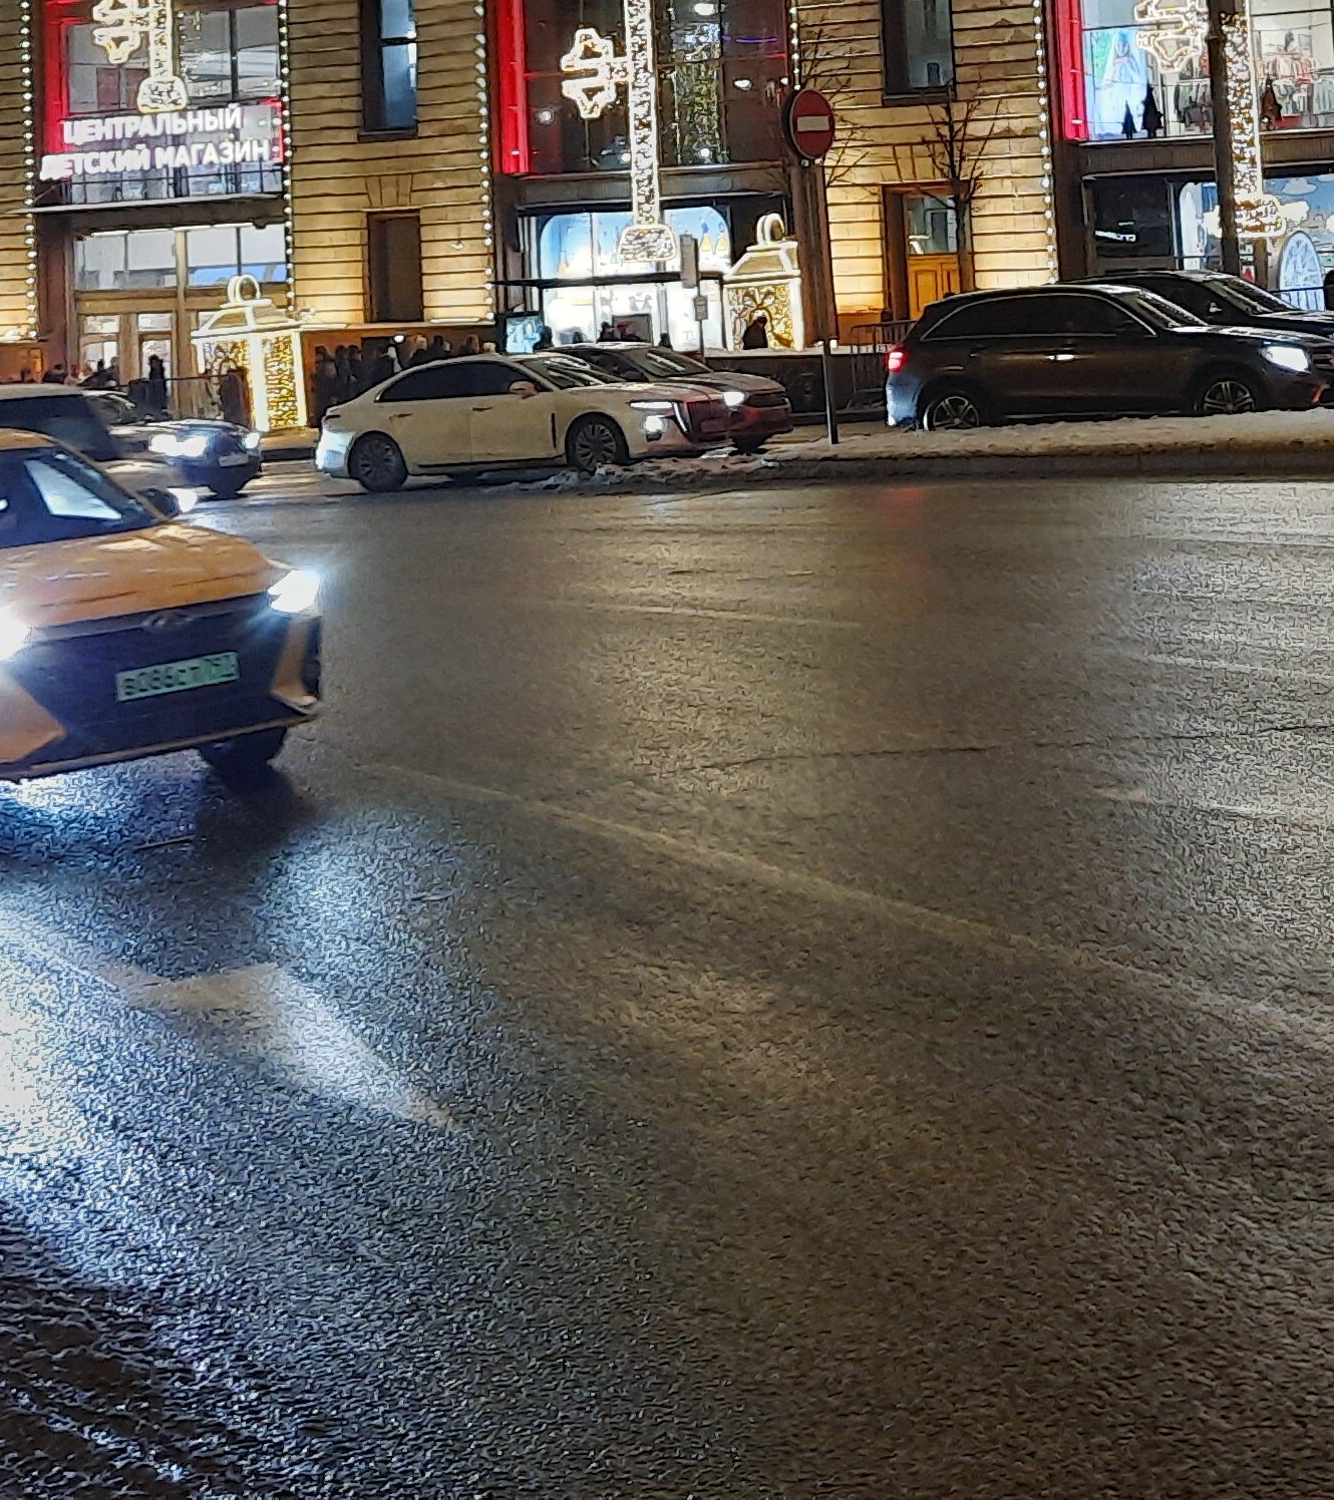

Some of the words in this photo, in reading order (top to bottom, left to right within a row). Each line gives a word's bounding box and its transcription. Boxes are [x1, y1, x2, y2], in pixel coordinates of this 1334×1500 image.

[62, 104, 243, 145] ЦЕНТРАЛЬНЫЙ
[40, 145, 151, 180] ДЕТСКИЙ
[154, 138, 271, 169] МАГАЗИН
